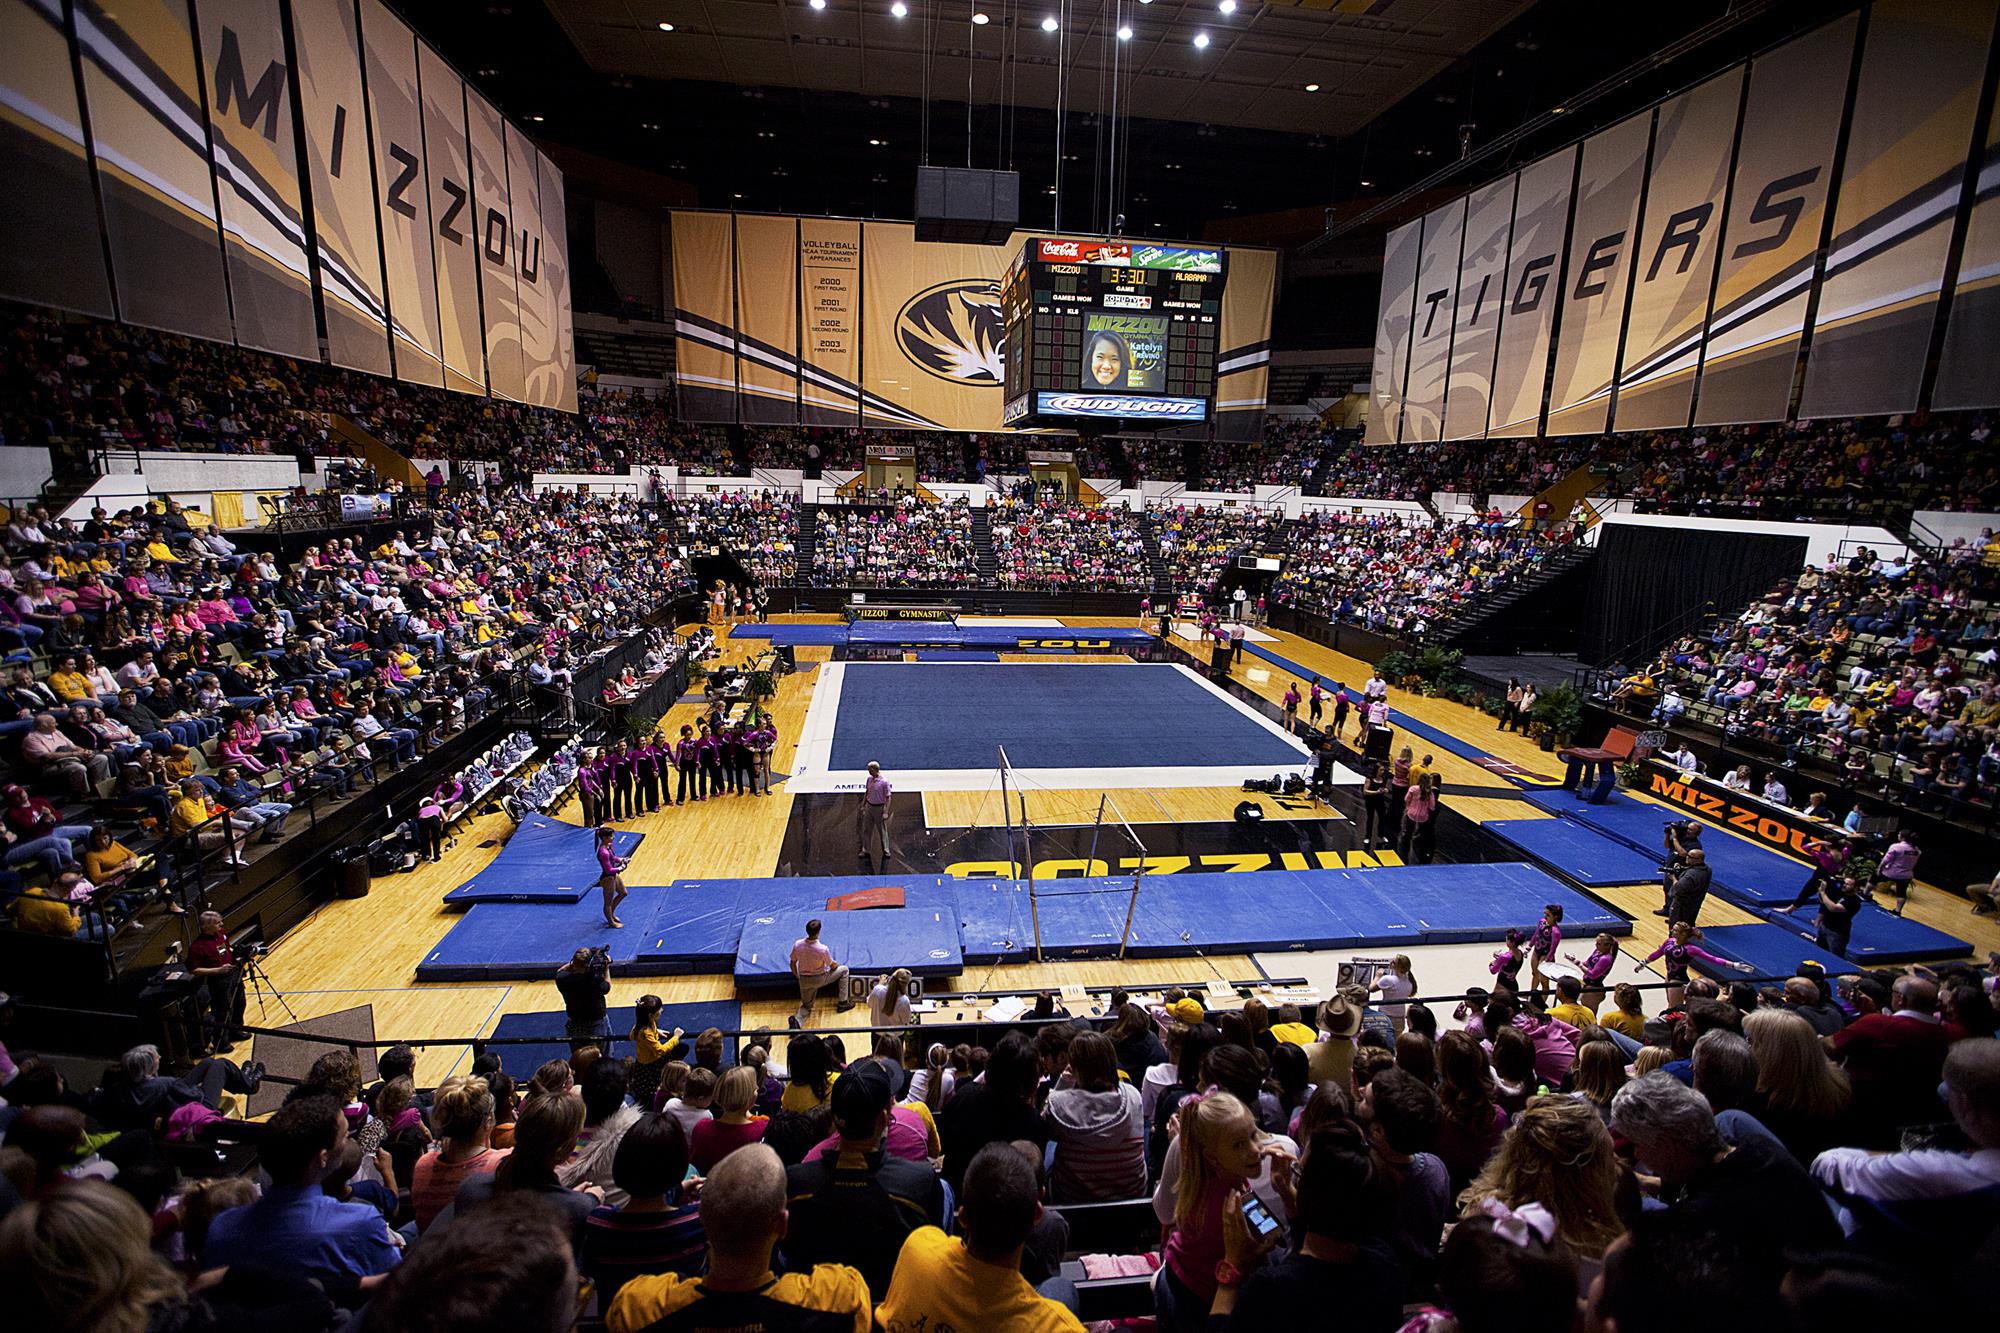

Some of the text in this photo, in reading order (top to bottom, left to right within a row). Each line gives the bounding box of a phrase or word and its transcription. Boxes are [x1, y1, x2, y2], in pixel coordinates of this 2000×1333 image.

[215, 25, 540, 284] MIZZOU
[803, 240, 858, 250] VOLLEYBALL
[1042, 241, 1080, 257] Coca-Cola
[1422, 165, 1822, 338] TIGERS
[1138, 249, 1164, 267] Sprite
[1051, 264, 1081, 275] MIZZOU
[820, 278, 841, 286] 2000
[1175, 272, 1207, 283] ALABAMA
[821, 299, 840, 307] 2001
[1052, 294, 1093, 303] GAMES WON
[1162, 300, 1201, 309] GAMES WON
[1087, 314, 1169, 335] MIZZOU
[820, 340, 841, 348] 2003
[1130, 341, 1163, 353] Katelyn
[1062, 398, 1198, 414] BUD LIGHT
[1650, 773, 1824, 858] MIZZOU
